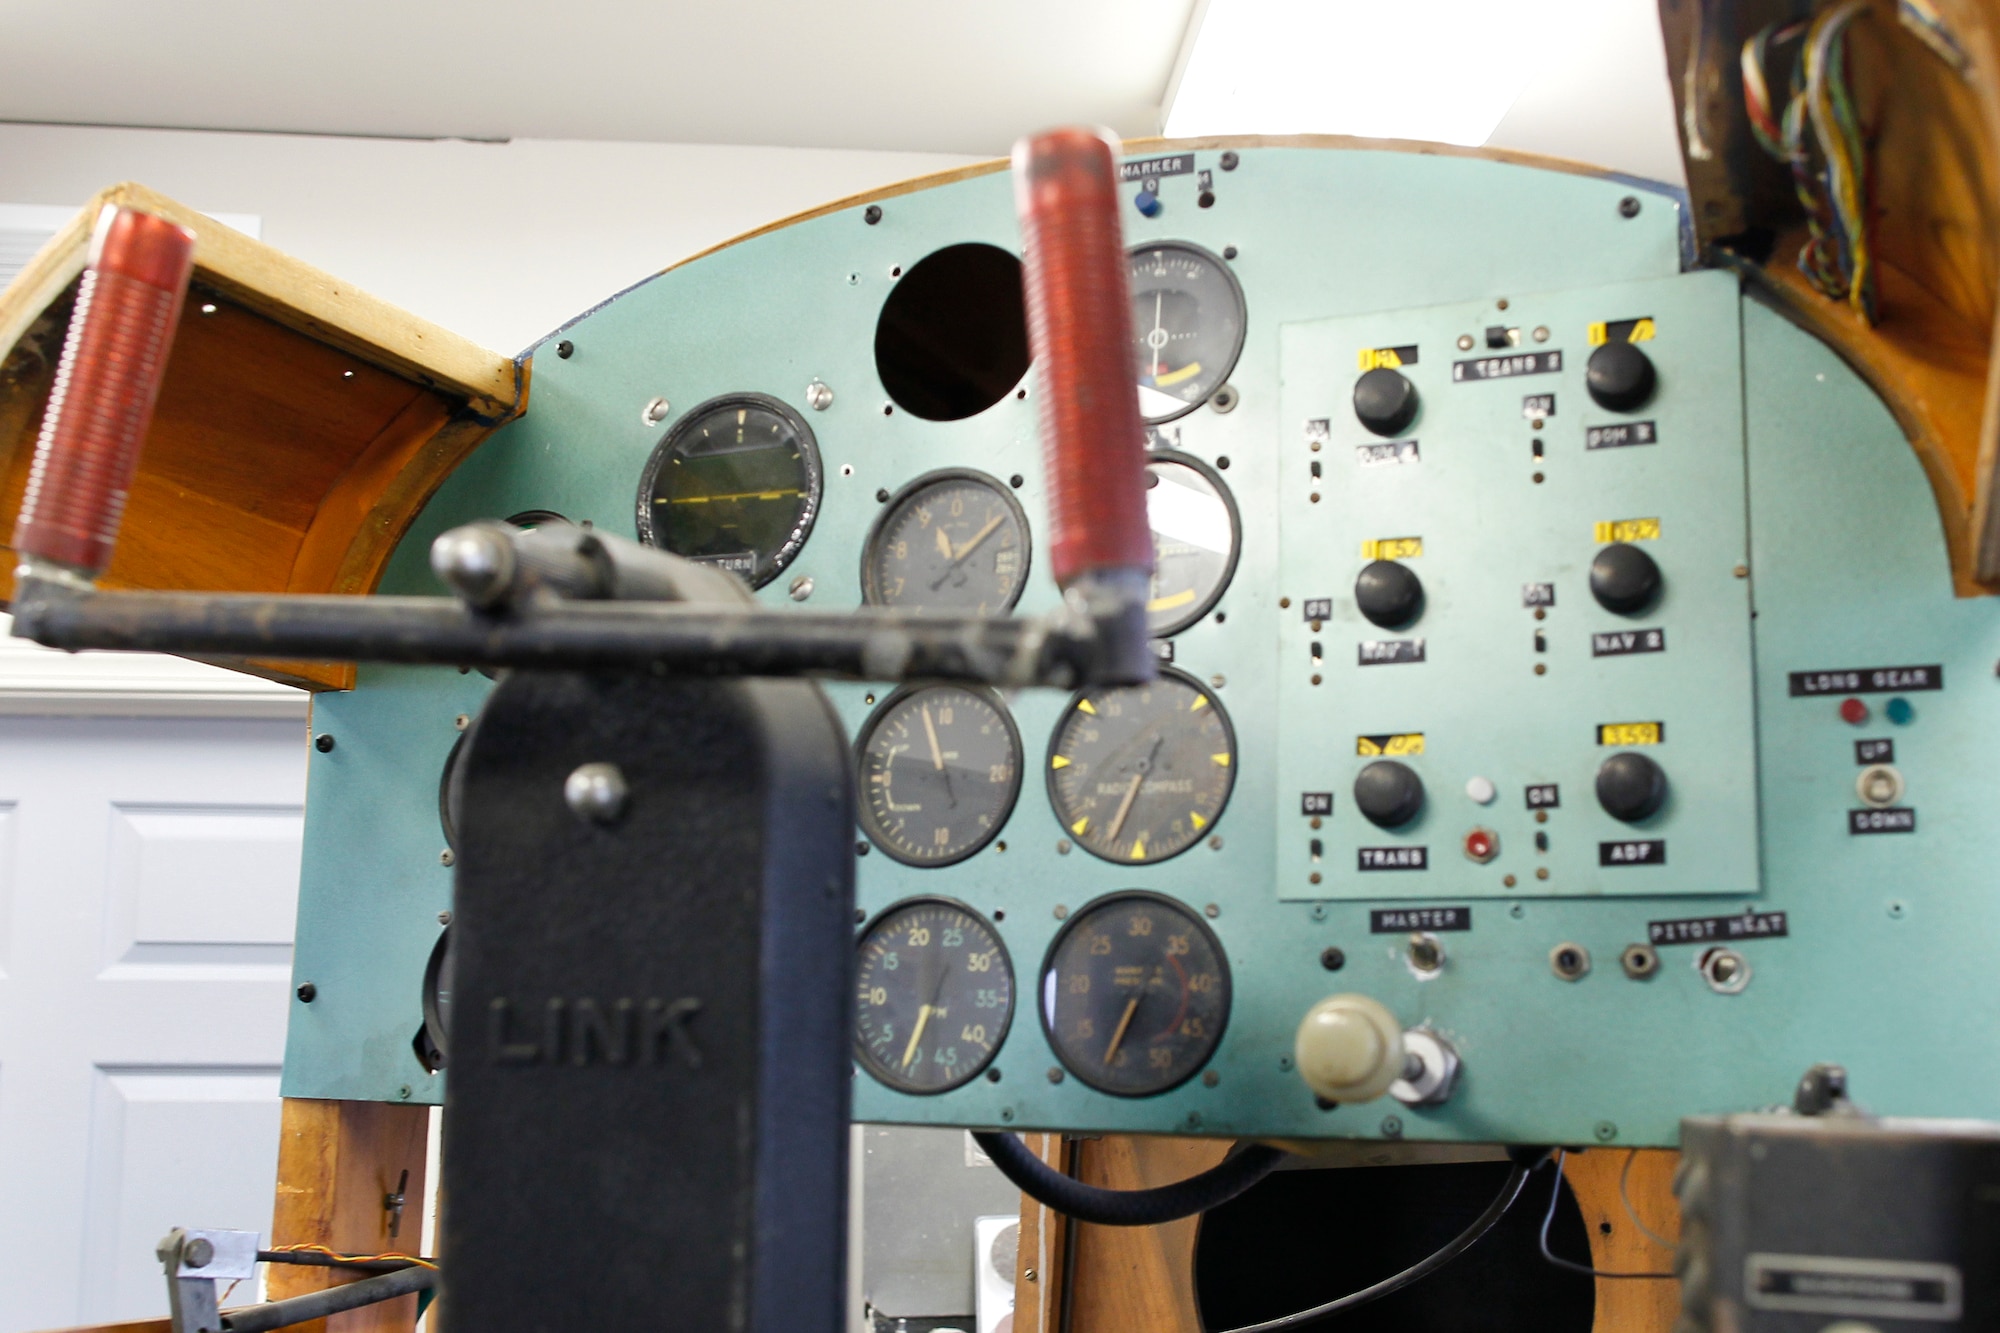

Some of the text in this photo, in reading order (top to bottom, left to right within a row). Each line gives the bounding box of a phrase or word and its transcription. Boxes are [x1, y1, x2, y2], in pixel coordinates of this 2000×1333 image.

[1120, 158, 1183, 178] MARKER
[951, 499, 964, 518] 0
[896, 541, 907, 560] 8
[717, 558, 752, 572] TURN
[895, 578, 905, 597] 7
[1595, 634, 1635, 651] NAV
[1872, 669, 1928, 687] GEAR
[939, 707, 953, 725] 10
[1860, 741, 1888, 760] UP
[990, 764, 1007, 783] 20
[1304, 796, 1328, 811] ON
[1528, 787, 1555, 804] ON
[1855, 812, 1912, 830] DOWN
[935, 827, 949, 846] 10
[1362, 849, 1423, 867] TRANS
[1611, 843, 1651, 861] ADF
[1129, 916, 1152, 937] 30
[1381, 910, 1457, 928] MASTER
[1650, 914, 1782, 941] PITOT HEAT
[908, 928, 930, 947] 20
[942, 928, 963, 947] 25
[1091, 935, 1112, 956] 25
[884, 952, 899, 970] 15
[967, 952, 990, 972] 30
[1189, 973, 1213, 993] 40
[870, 987, 886, 1006] 10
[976, 989, 998, 1008] 35
[491, 996, 702, 1071] LINK
[883, 1023, 894, 1042] 5
[961, 1024, 985, 1043] 40
[1181, 1019, 1203, 1039] 45
[934, 1047, 957, 1066] 45
